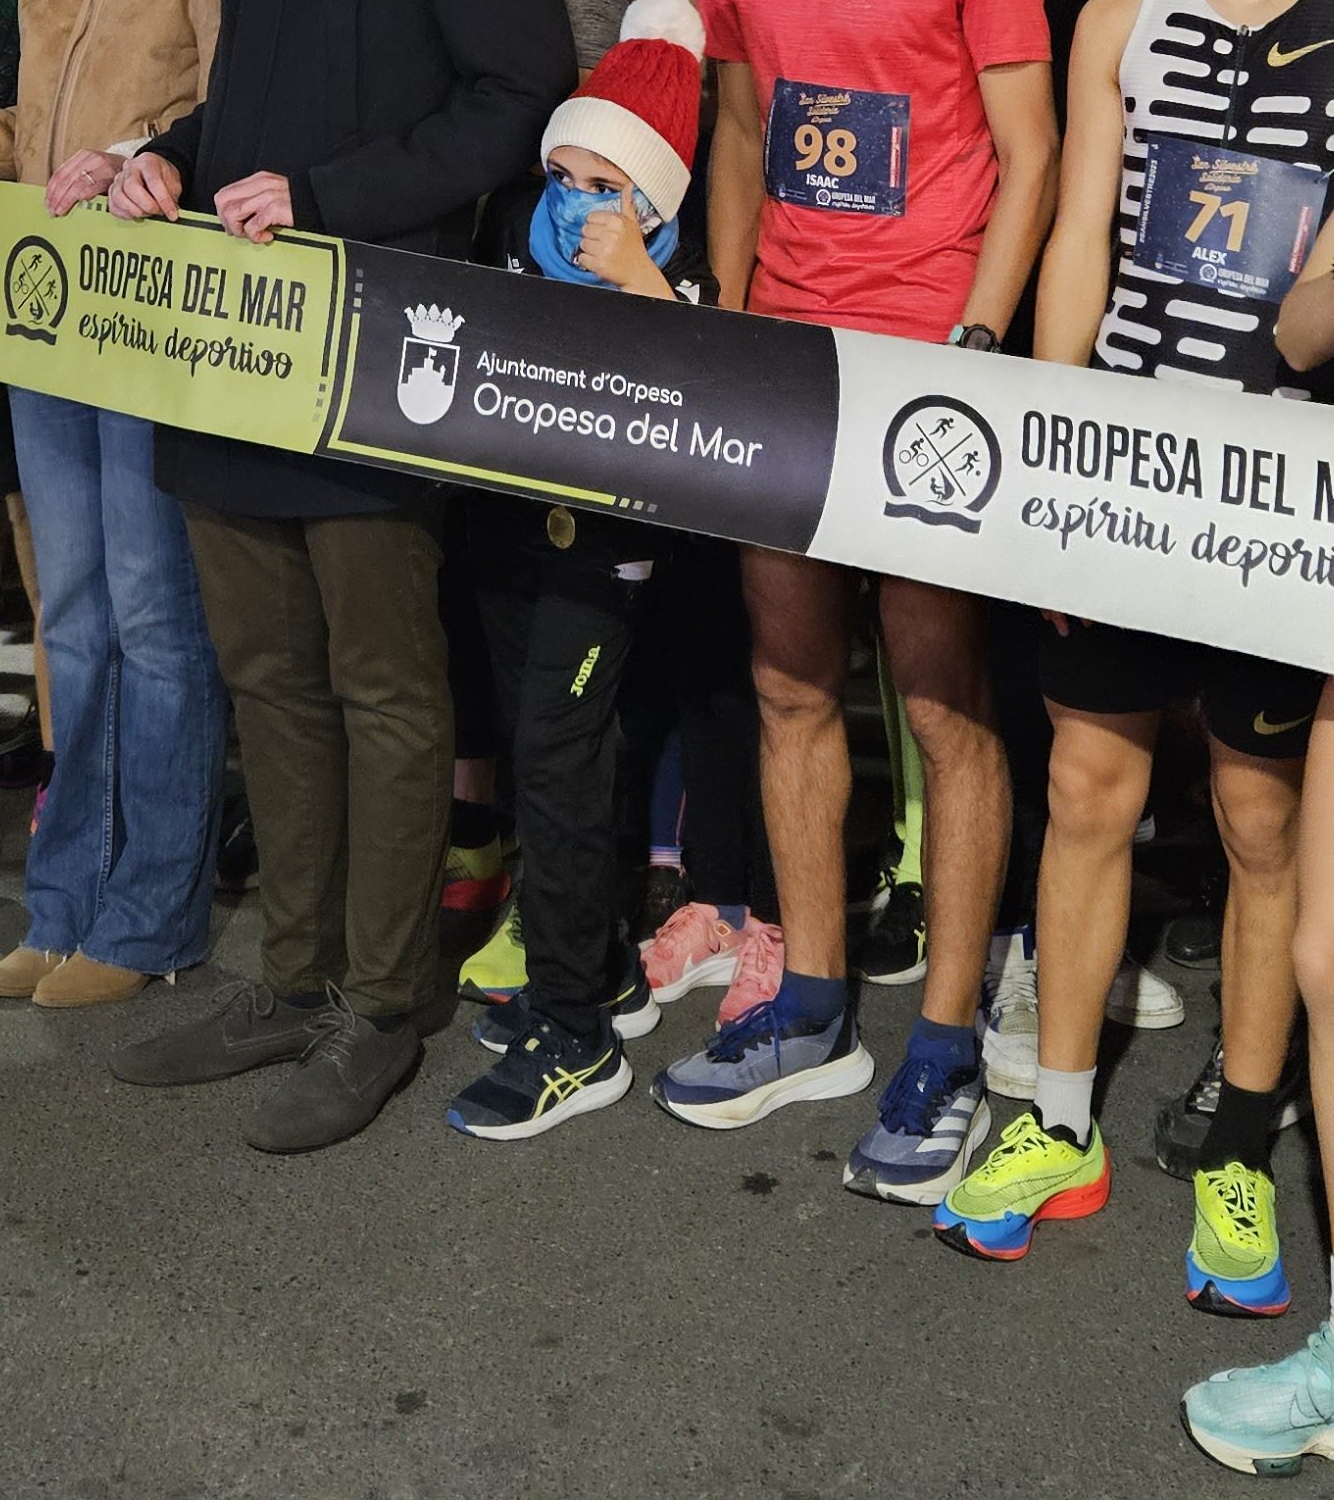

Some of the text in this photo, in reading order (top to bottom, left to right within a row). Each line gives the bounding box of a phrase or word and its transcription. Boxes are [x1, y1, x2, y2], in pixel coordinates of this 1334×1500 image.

[794, 124, 857, 177] 98
[805, 173, 840, 189] ISAAC
[1184, 190, 1250, 252] 71
[1192, 246, 1227, 265] ALEX
[79, 243, 307, 334] OROPESA DEL MAR
[476, 349, 587, 391] Ajuntament
[473, 381, 763, 468] Oropesa del Mar
[1020, 410, 1204, 499] OROPESA
[1220, 444, 1296, 517] DEL
